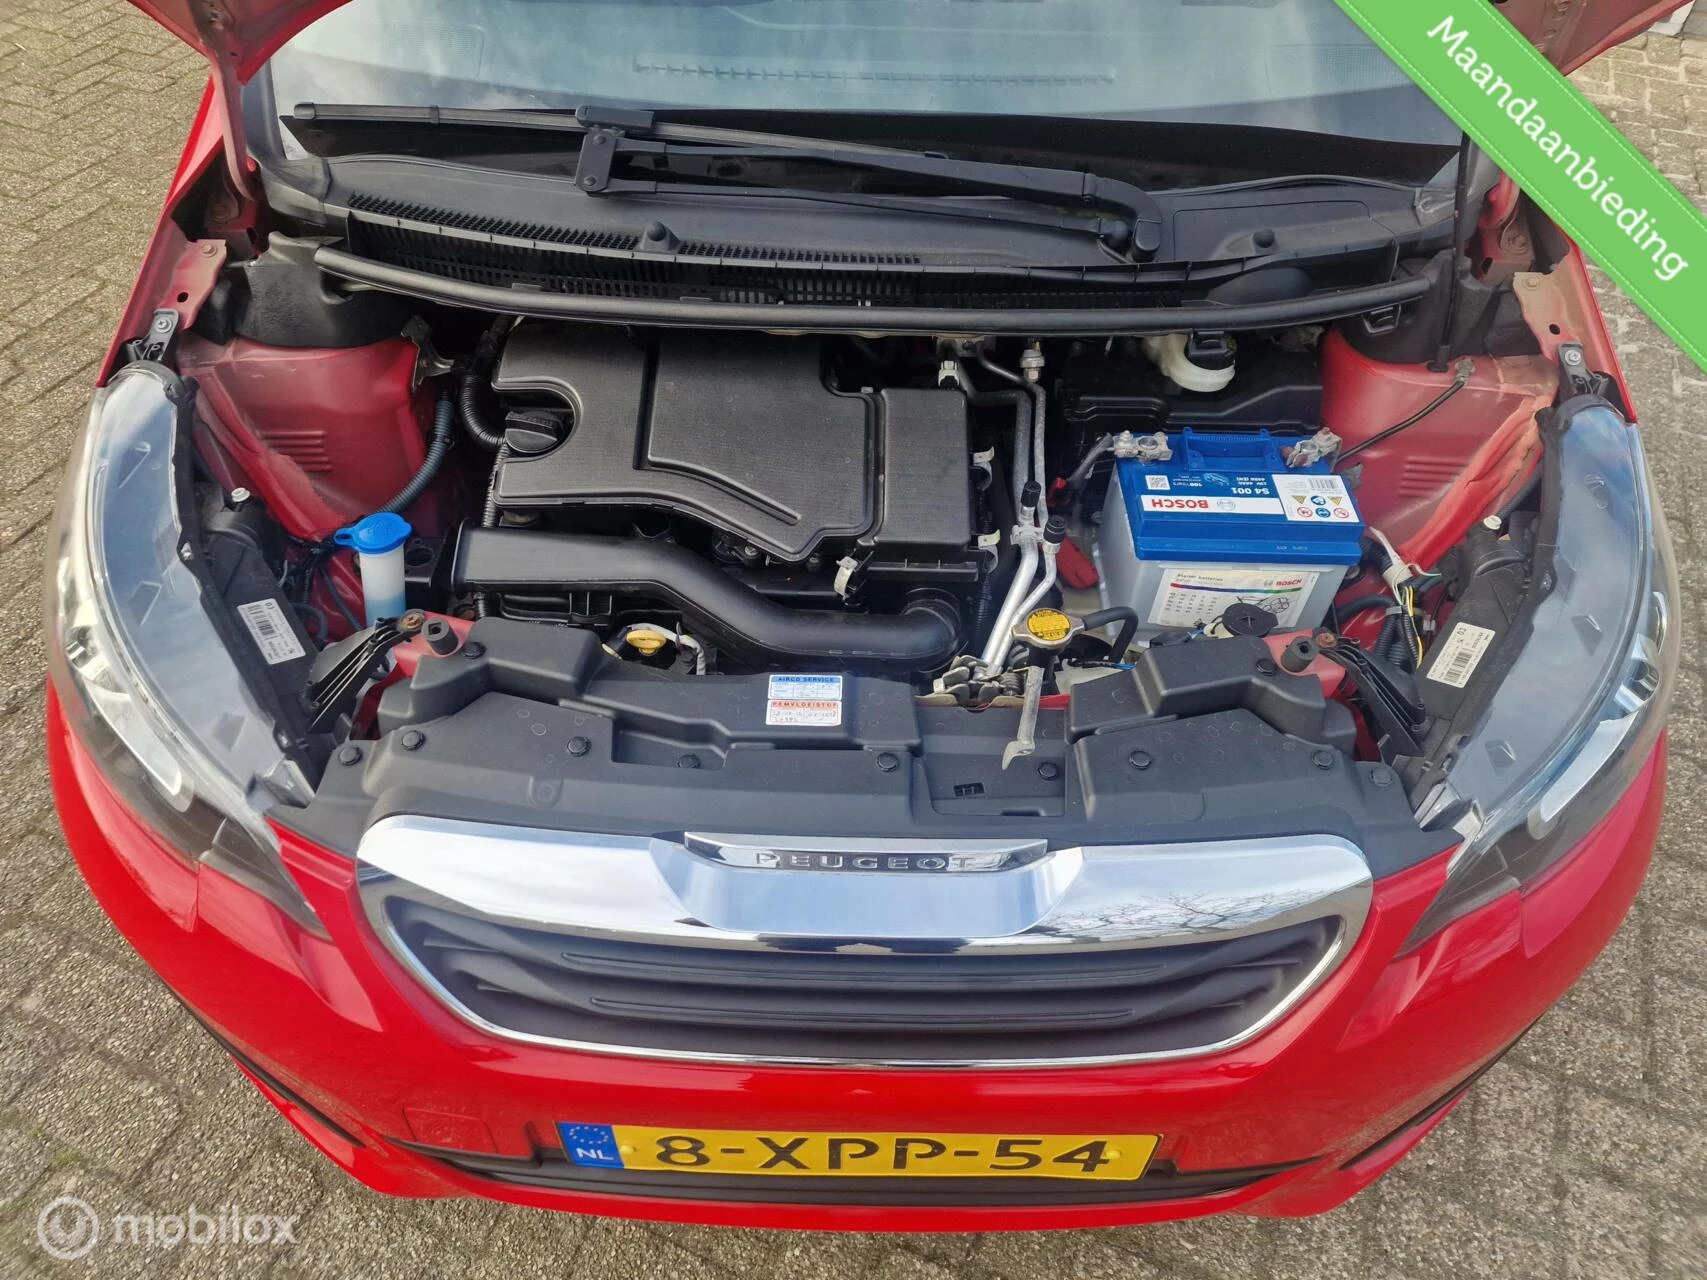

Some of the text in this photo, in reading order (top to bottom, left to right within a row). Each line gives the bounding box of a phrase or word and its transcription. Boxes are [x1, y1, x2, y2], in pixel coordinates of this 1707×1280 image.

[1231, 487, 1270, 495] S4 001
[1151, 499, 1209, 509] BOSCH
[1275, 578, 1303, 586] BOSCH
[756, 851, 977, 873] PEUGEOT
[577, 1147, 614, 1161] NL
[655, 1134, 1111, 1173] 8-XPP-54
